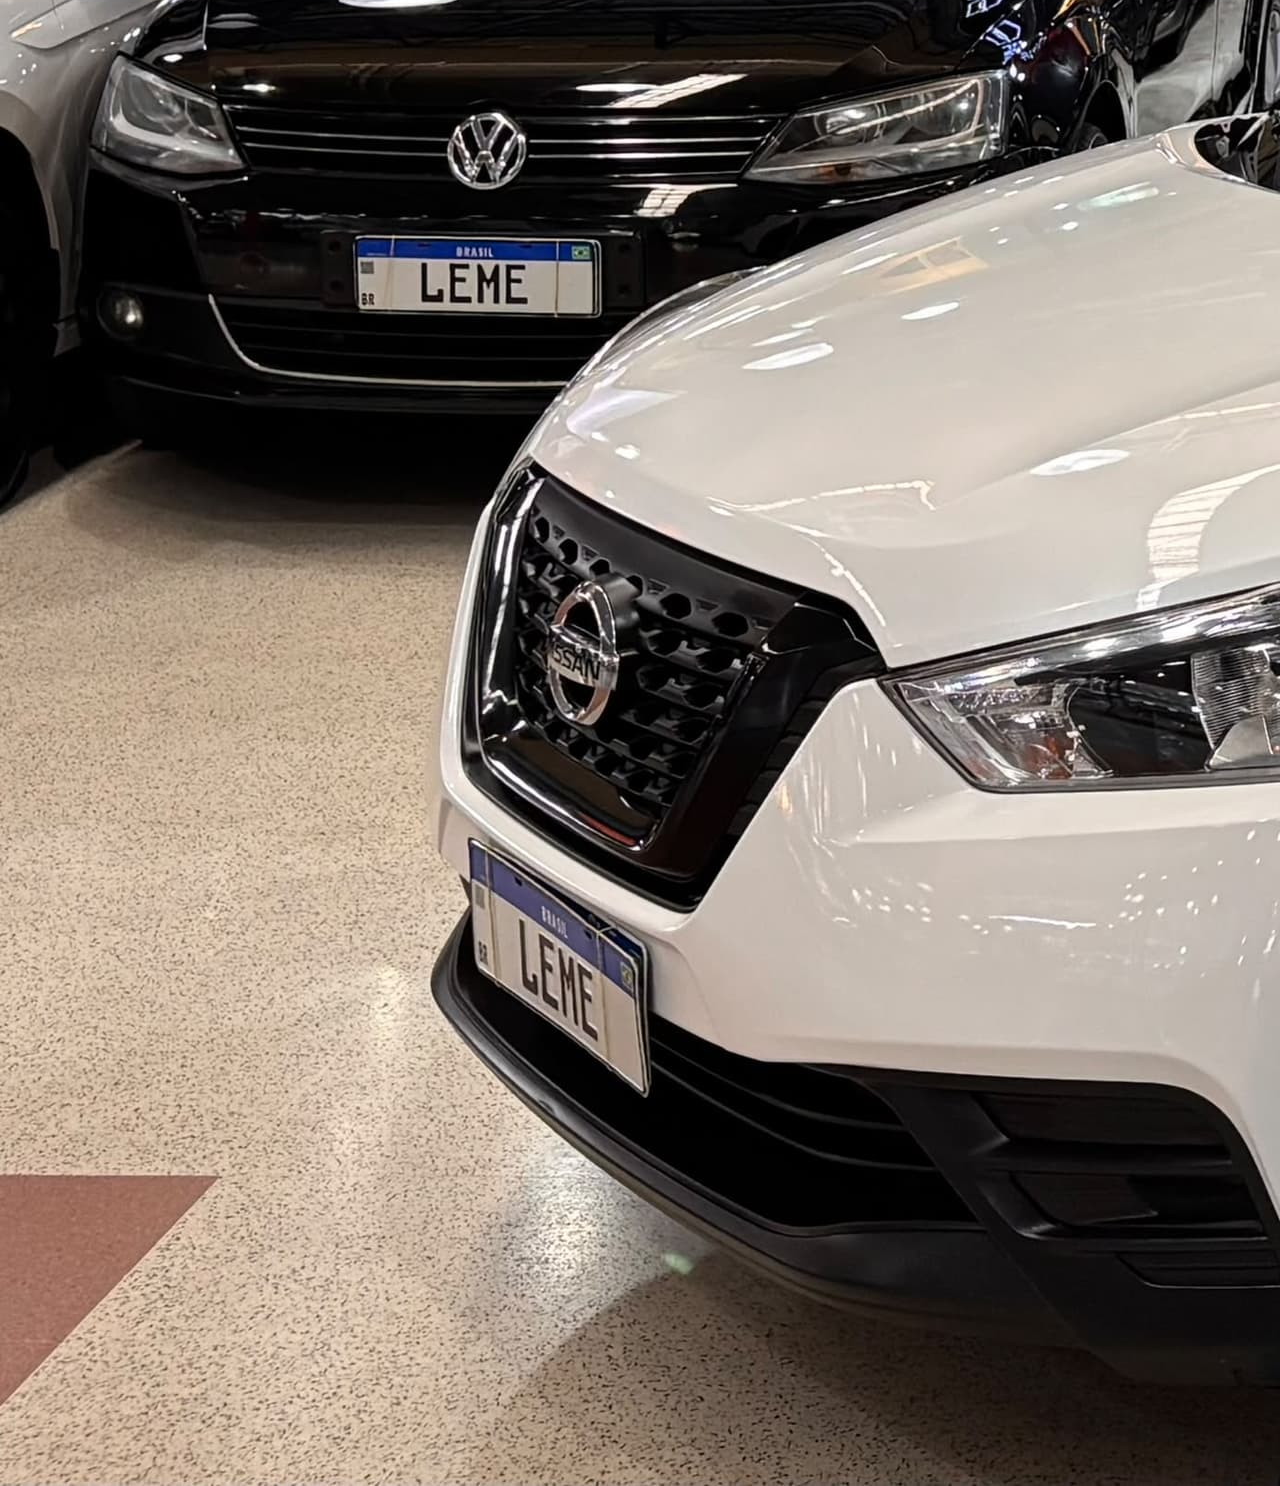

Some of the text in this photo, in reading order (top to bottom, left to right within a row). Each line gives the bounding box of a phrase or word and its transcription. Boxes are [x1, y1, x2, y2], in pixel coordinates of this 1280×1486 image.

[456, 246, 494, 258] BRASIL
[421, 262, 529, 304] LEME
[519, 918, 599, 1042] LEME
